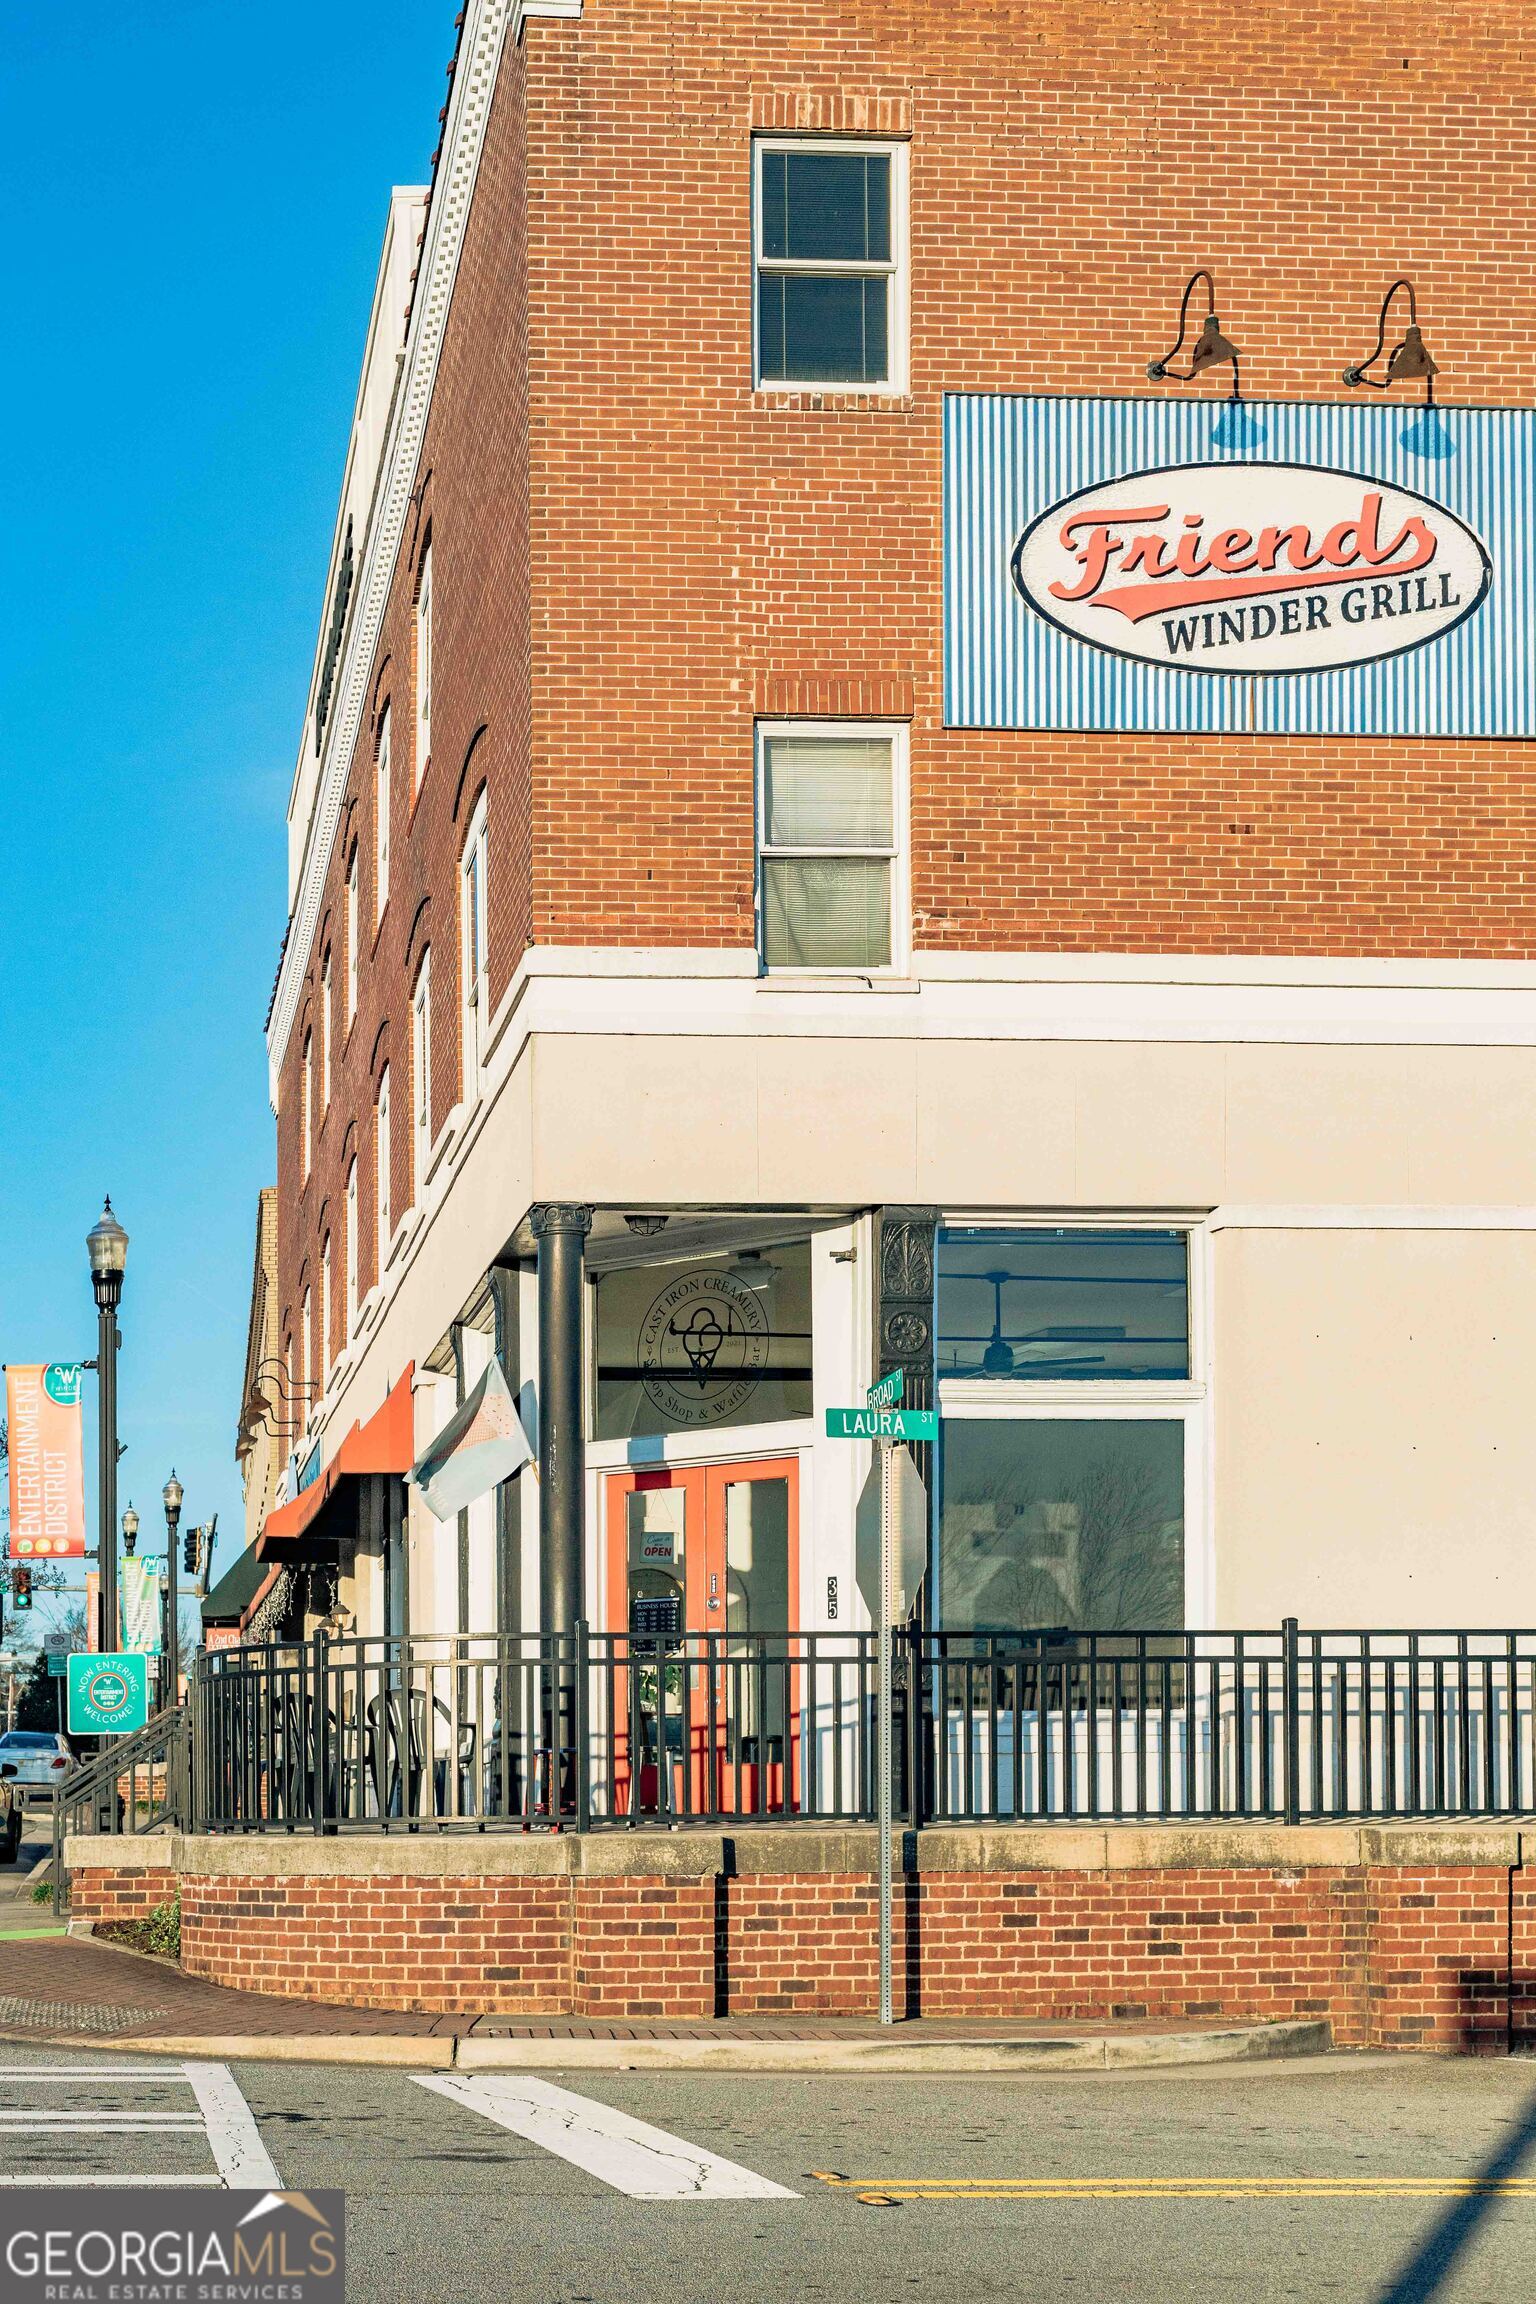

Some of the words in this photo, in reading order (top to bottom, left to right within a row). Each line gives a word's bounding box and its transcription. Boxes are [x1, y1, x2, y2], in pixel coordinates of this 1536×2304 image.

[1047, 492, 1438, 601] Friends
[1162, 594, 1331, 655] WINDER
[1340, 572, 1461, 624] GRILL
[645, 1305, 666, 1344] CAST
[665, 1278, 701, 1307] IRON
[703, 1277, 762, 1331] CREAMERY
[648, 1358, 664, 1399] Sop
[664, 1396, 693, 1421] Shop
[698, 1408, 708, 1419] &
[867, 1379, 894, 1410] BROAD
[895, 1369, 901, 1381] ST
[842, 1412, 906, 1435] LAURA
[921, 1411, 934, 1423] ST
[15, 1375, 43, 1536] ENTERTAINMENT
[43, 1450, 68, 1536] DISTRICT
[644, 1546, 672, 1557] OPEN
[208, 1634, 214, 1645] A
[228, 1634, 241, 1645] Cha
[78, 1667, 95, 1693] NOW
[95, 1660, 139, 1693] ENTERING
[83, 1703, 135, 1724] WELCOME!
